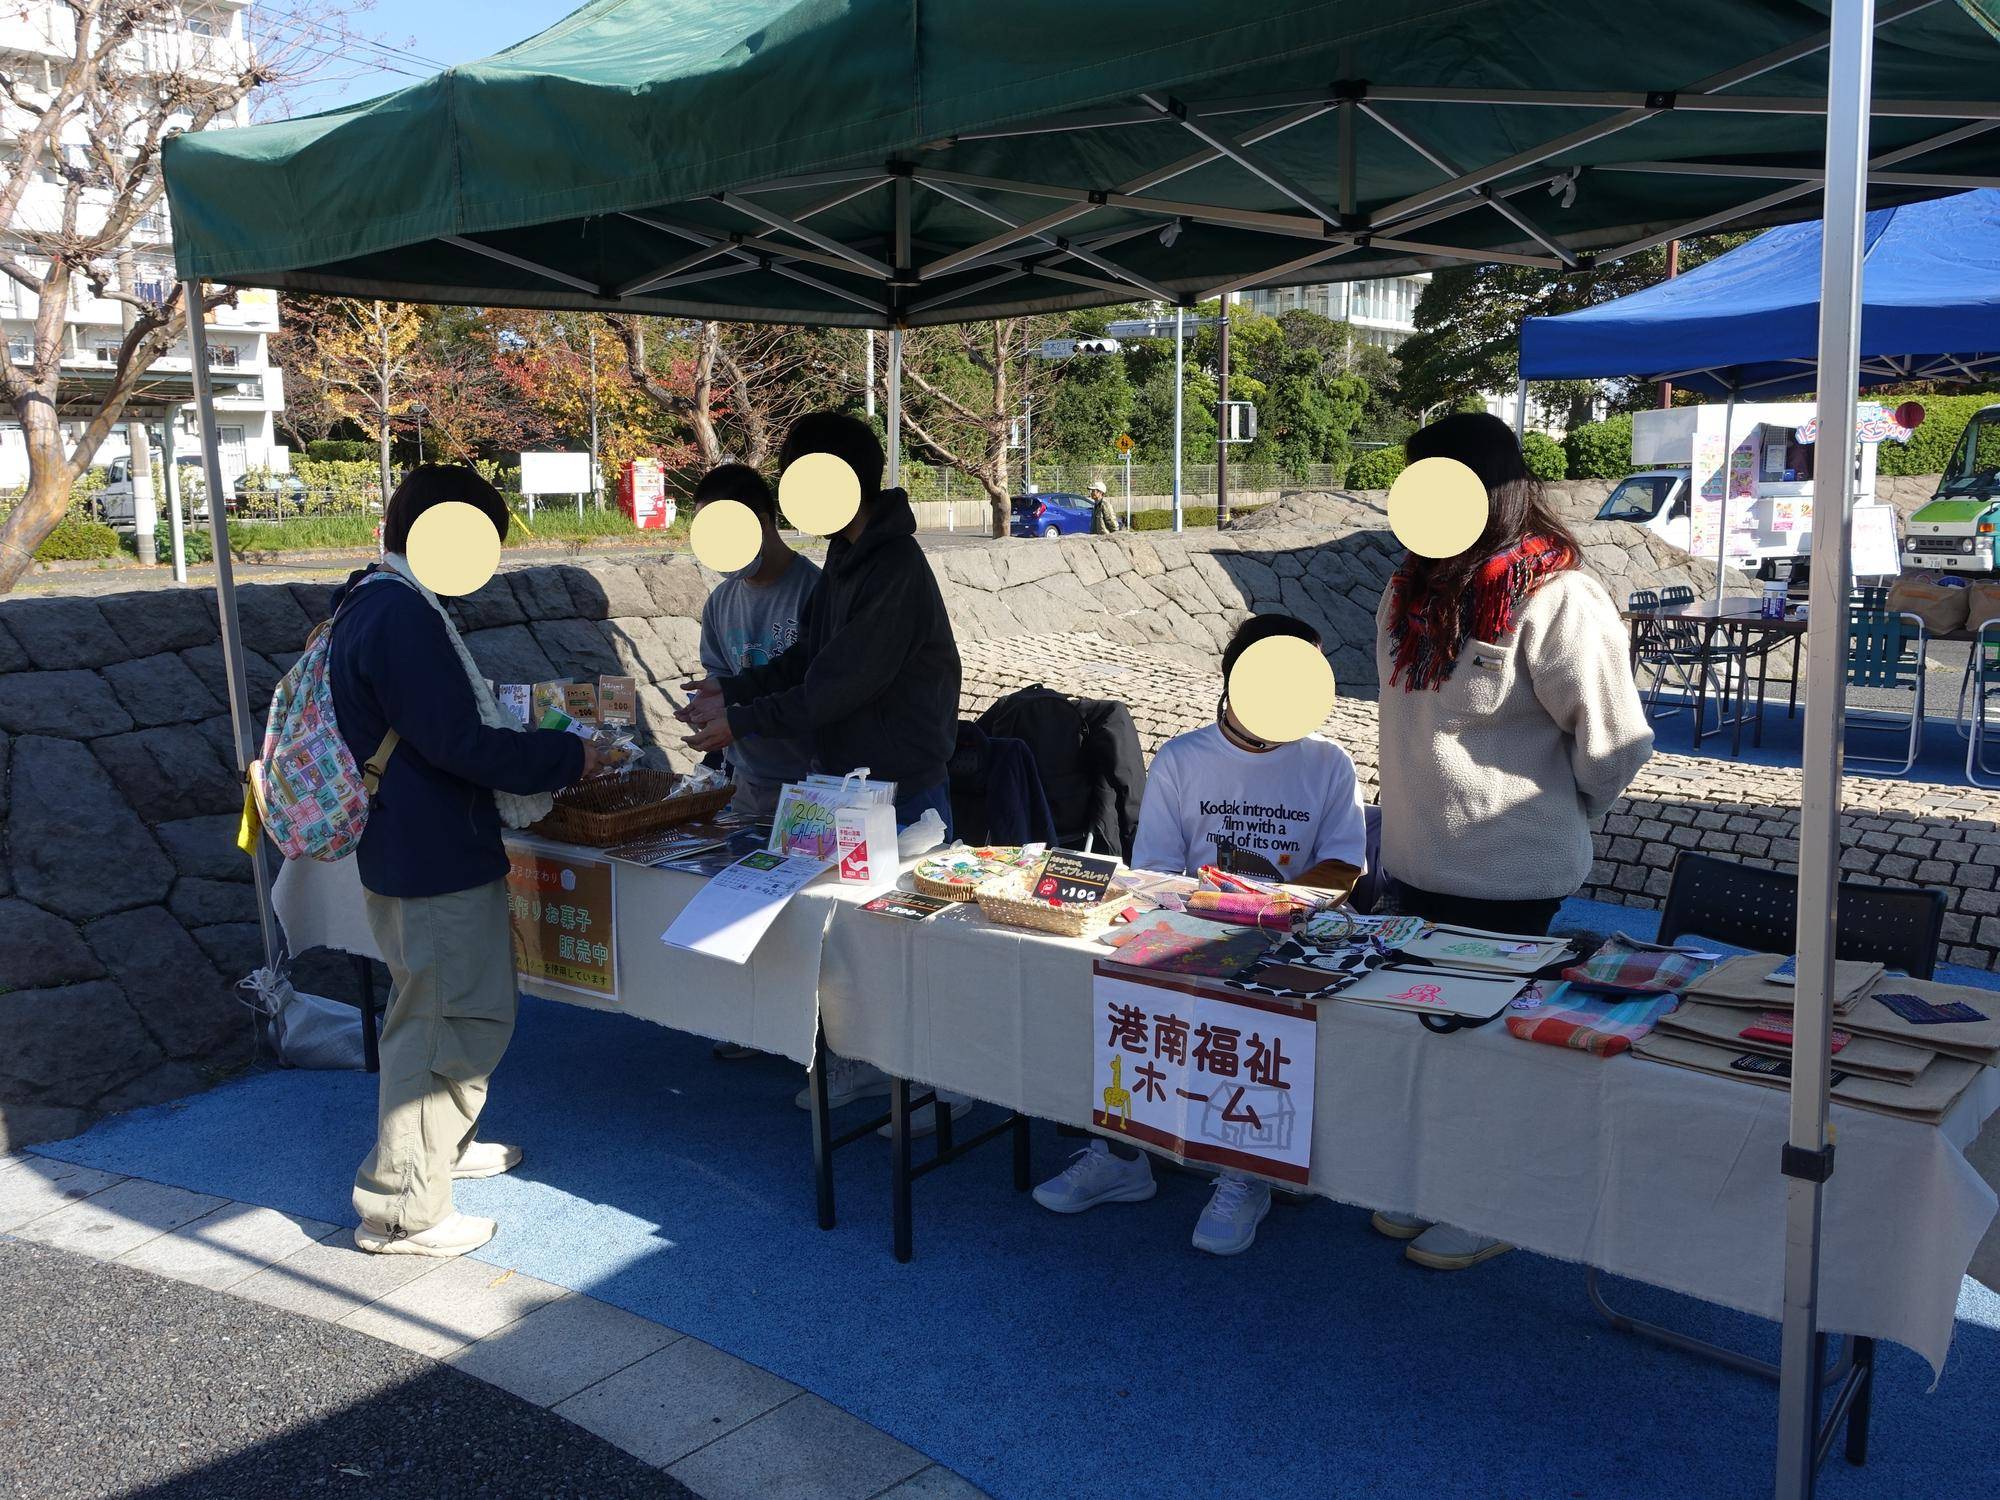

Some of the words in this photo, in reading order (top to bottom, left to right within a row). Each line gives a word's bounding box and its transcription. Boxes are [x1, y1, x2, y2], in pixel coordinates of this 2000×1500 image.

[795, 802, 837, 825] 2026
[1200, 799, 1240, 816] Kodak
[1242, 801, 1310, 822] introduces
[1221, 815, 1244, 831] film
[1246, 818, 1276, 835] with
[1278, 824, 1287, 836] a
[1206, 830, 1235, 847] mind
[1237, 834, 1252, 849] of
[1253, 834, 1269, 850] its
[1270, 838, 1301, 853] own.
[559, 934, 609, 967] 販売中
[1108, 1002, 1291, 1089] 港南福祉
[1131, 1060, 1263, 1130] ホーム
